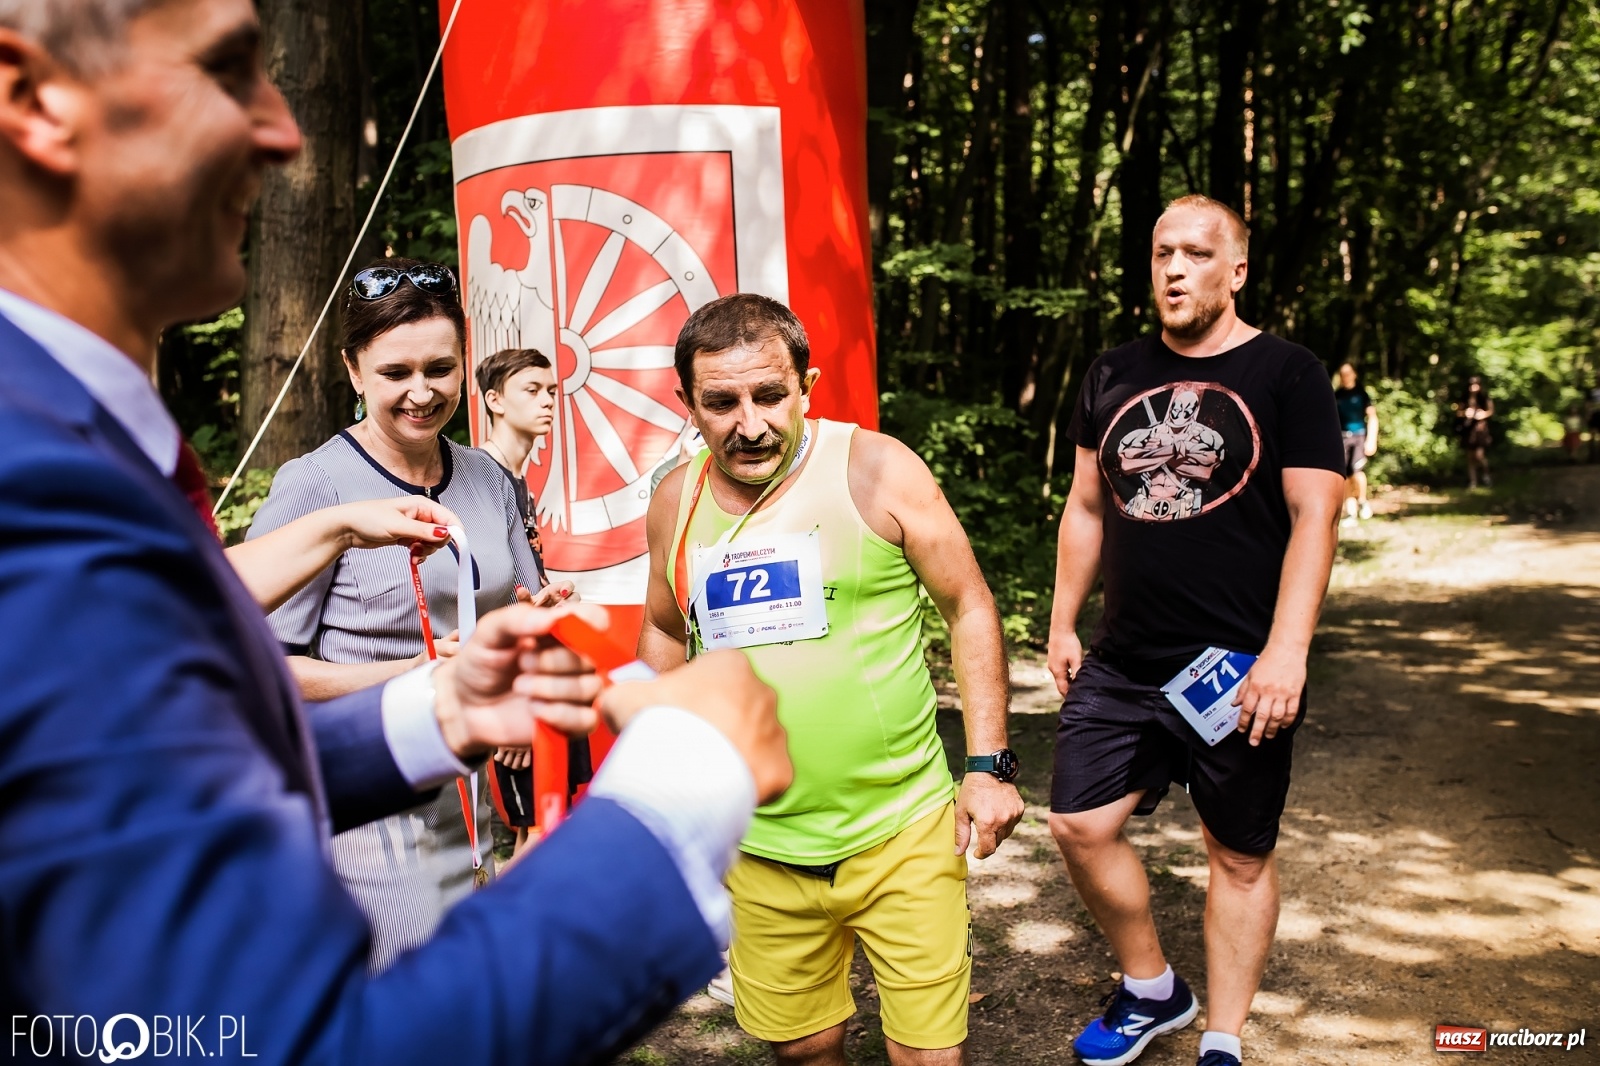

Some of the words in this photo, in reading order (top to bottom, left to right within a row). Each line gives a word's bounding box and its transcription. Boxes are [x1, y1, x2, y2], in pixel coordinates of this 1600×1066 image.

[727, 569, 771, 601] 72
[769, 601, 784, 610] godz.
[1202, 659, 1240, 694] 71
